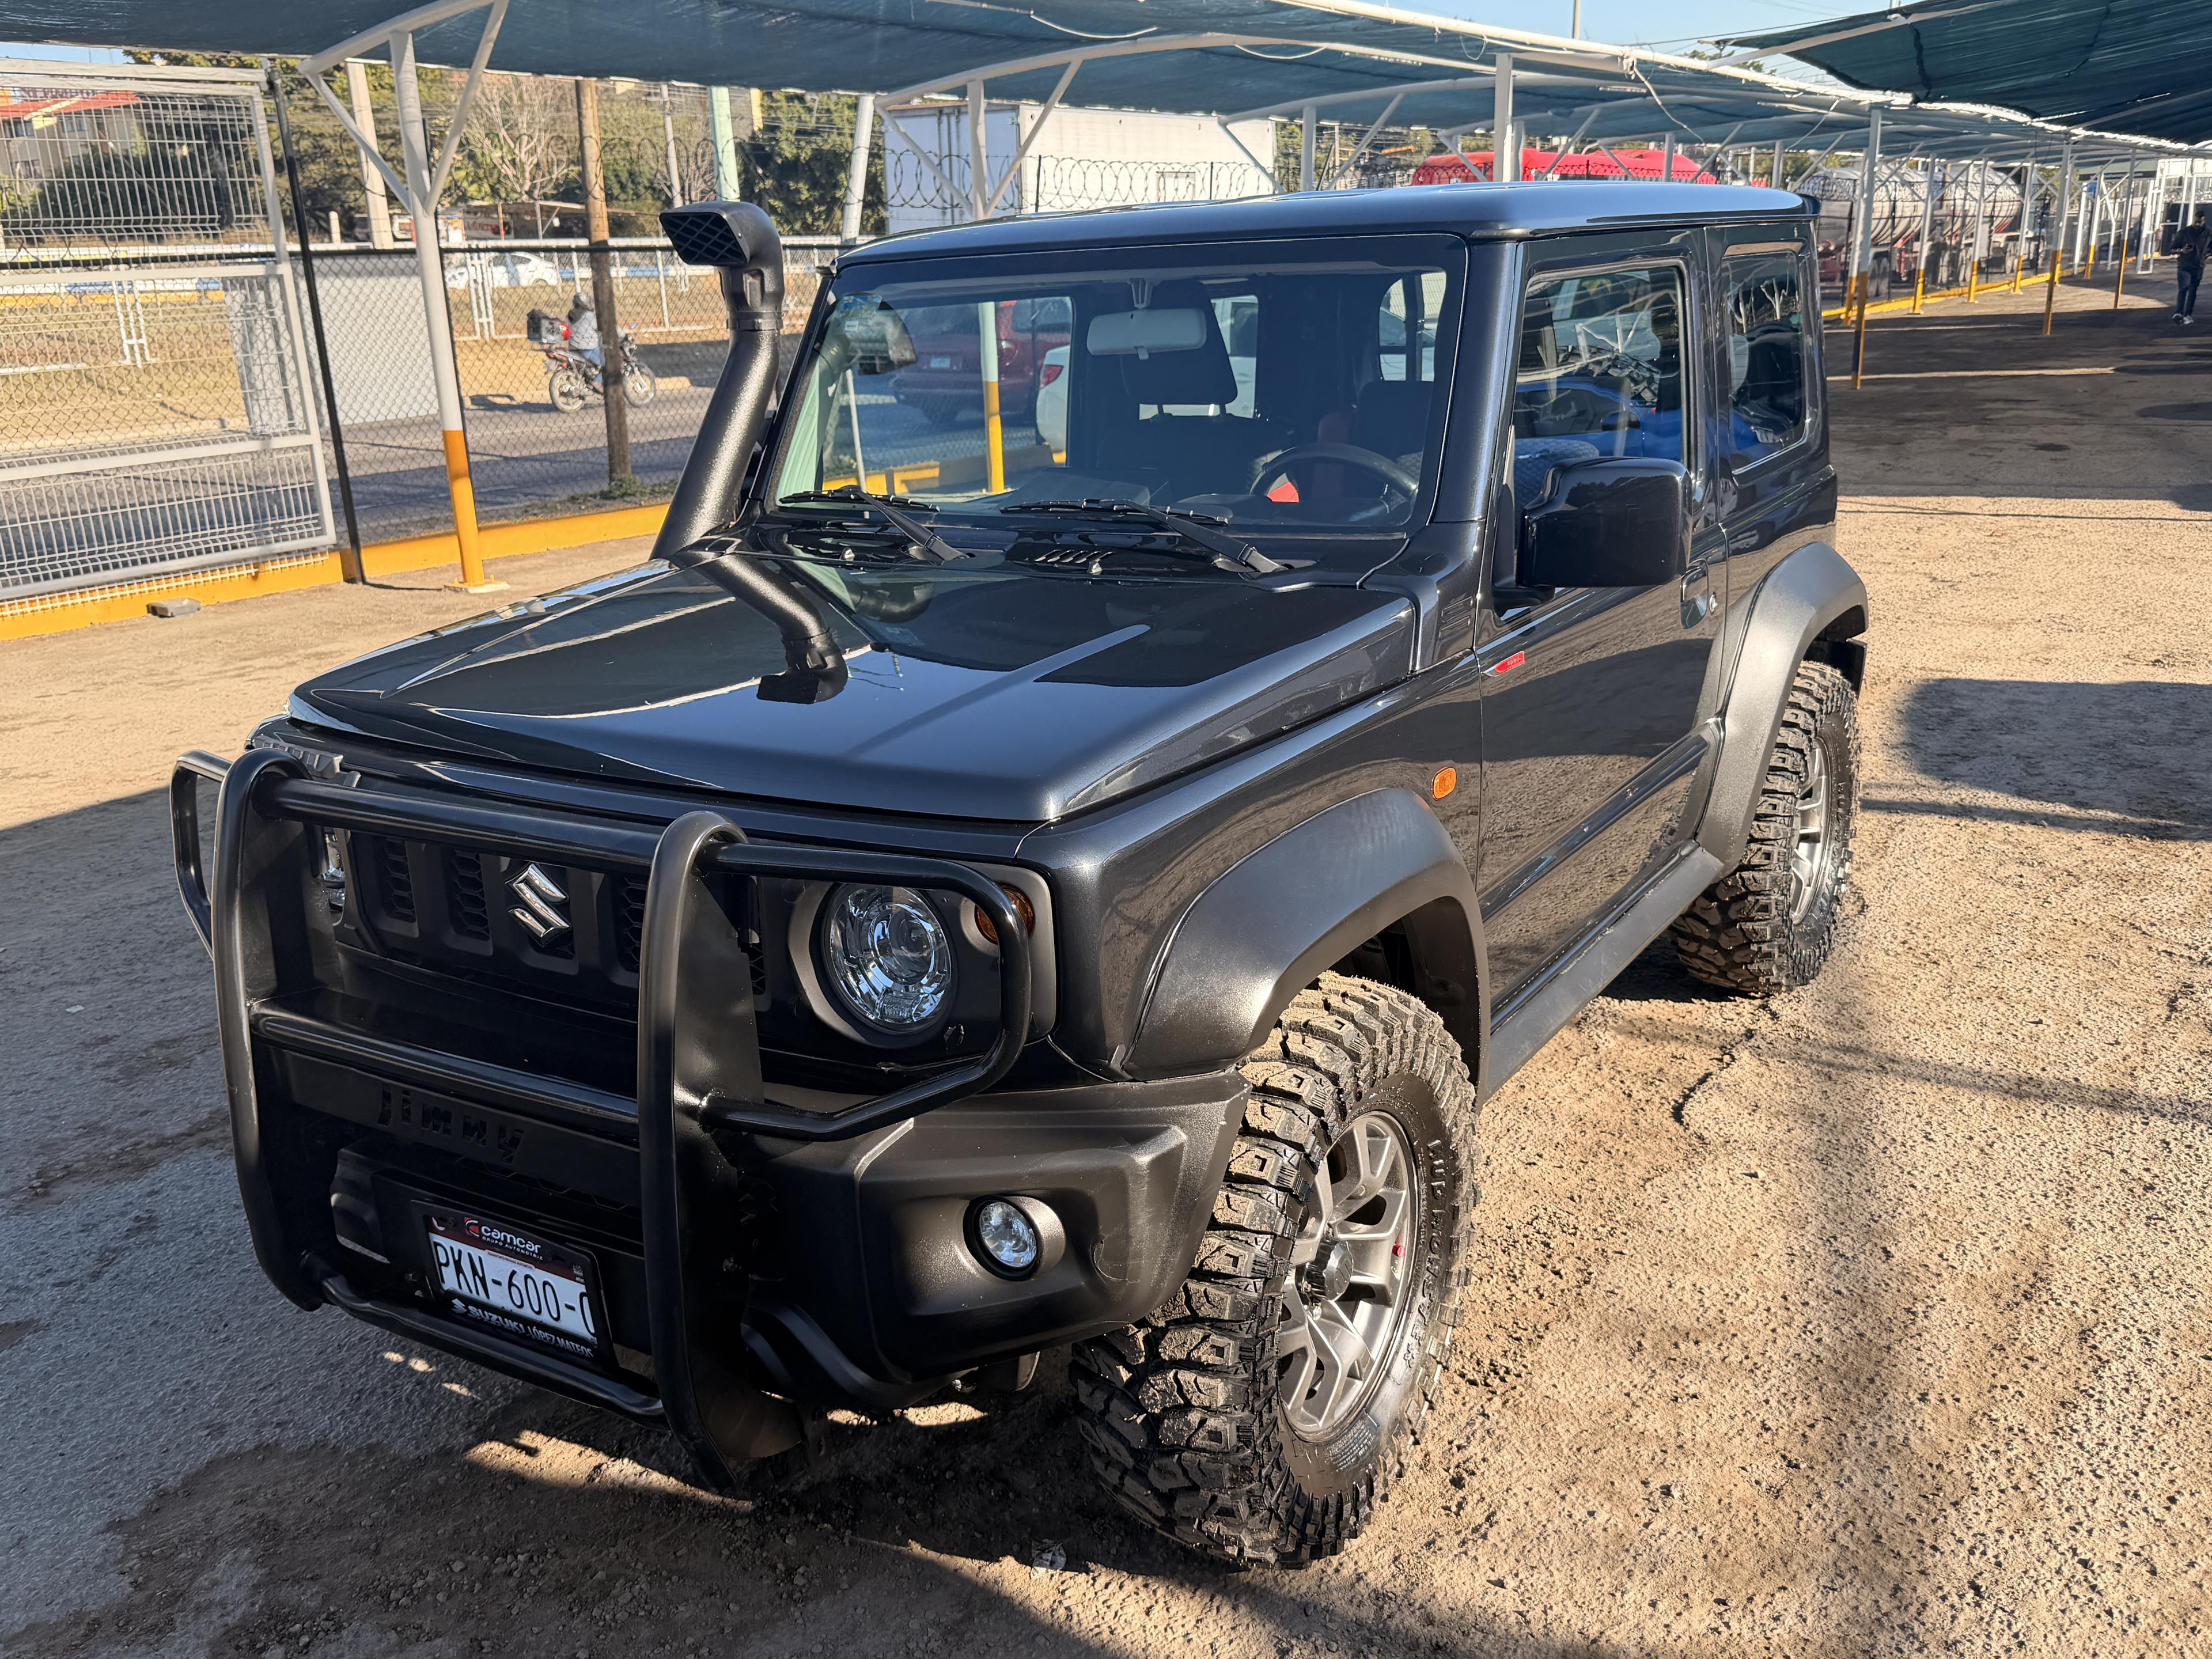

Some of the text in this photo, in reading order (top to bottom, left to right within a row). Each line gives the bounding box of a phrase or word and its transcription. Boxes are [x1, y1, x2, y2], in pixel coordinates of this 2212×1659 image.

[1427, 1139, 1447, 1200] MUD
[481, 1225, 541, 1253] camcar
[505, 1243, 543, 1261] AUTOMOTRIZ
[467, 1305, 525, 1334] SUZUKI
